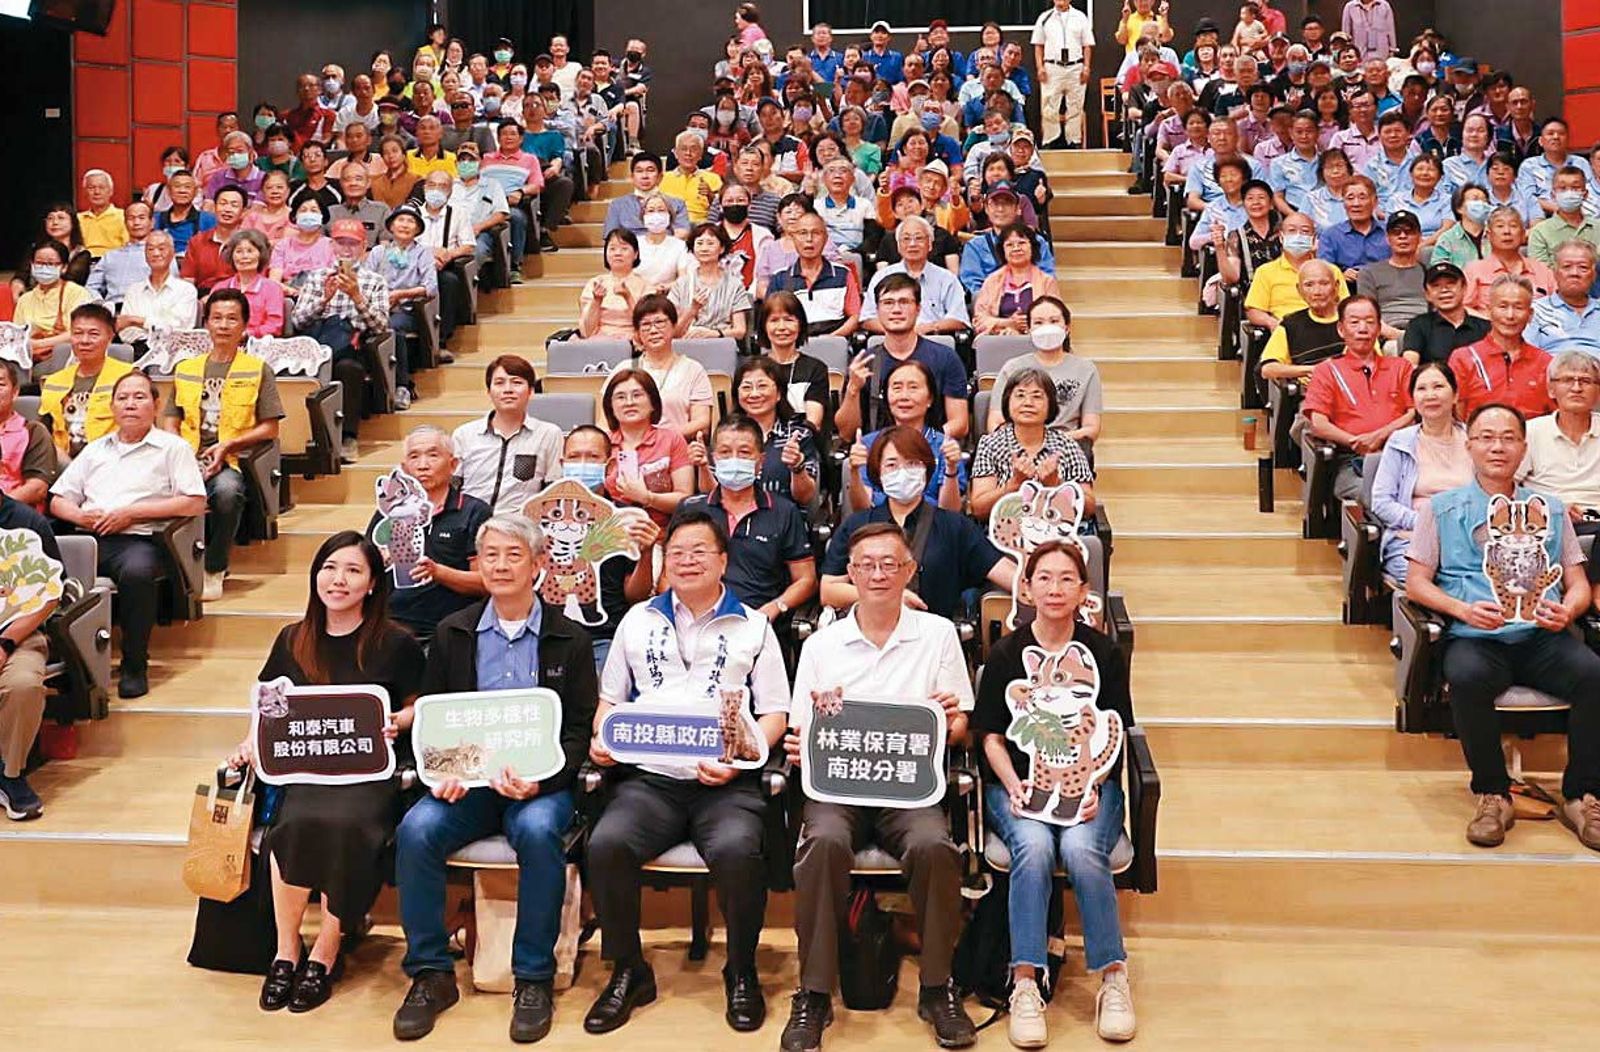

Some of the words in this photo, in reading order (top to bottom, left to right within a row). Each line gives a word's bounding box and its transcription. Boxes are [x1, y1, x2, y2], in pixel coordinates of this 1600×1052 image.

[288, 718, 355, 737] 和泰汽車
[446, 704, 541, 728] 生物多樣性
[484, 729, 542, 751] 研究所
[612, 722, 719, 747] 南投縣政府
[817, 727, 931, 756] 林業保育署
[273, 737, 373, 758] 股份有限公司
[827, 756, 917, 783] 南投分署
